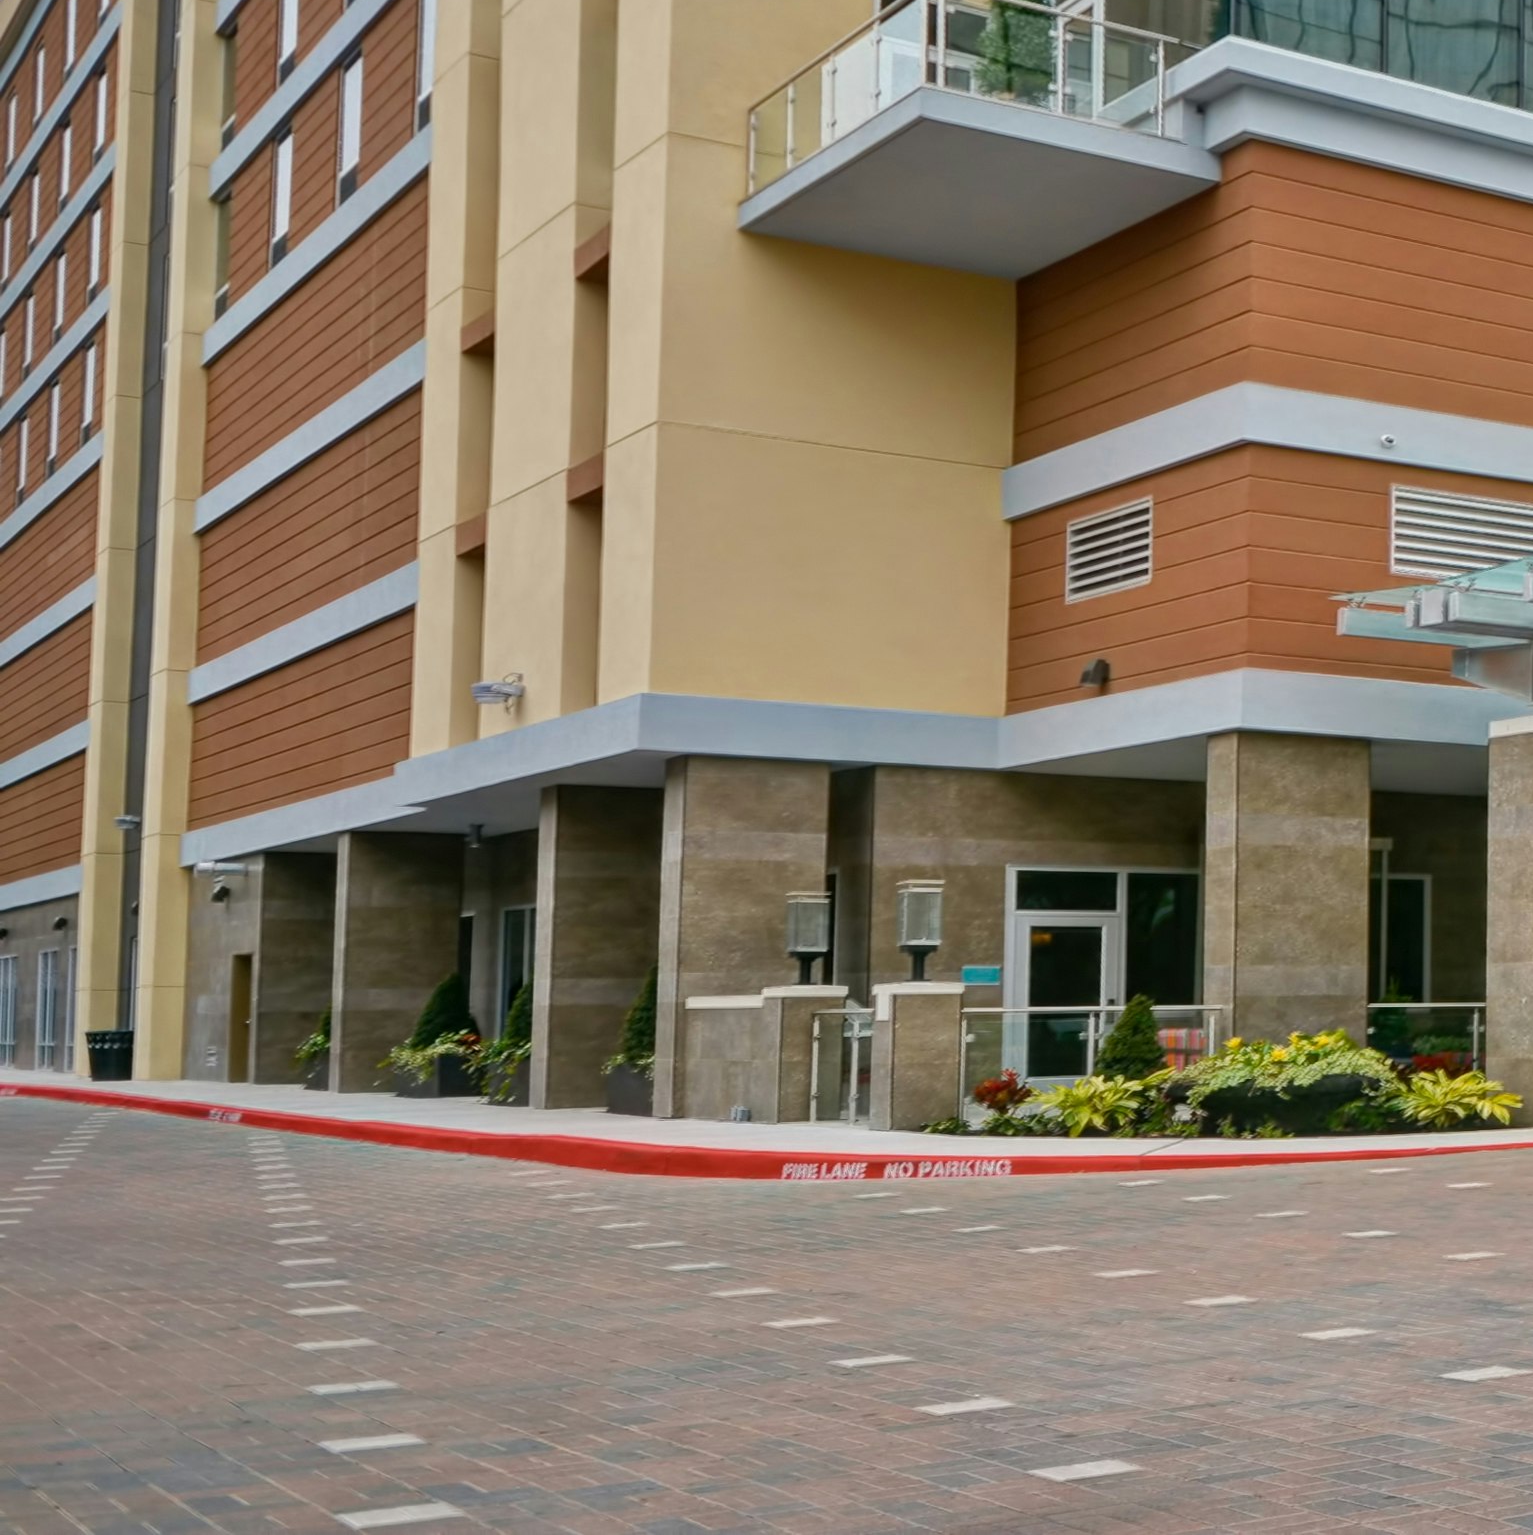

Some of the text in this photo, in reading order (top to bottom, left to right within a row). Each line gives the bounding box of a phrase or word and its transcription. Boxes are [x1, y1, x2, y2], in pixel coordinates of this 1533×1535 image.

[780, 1159, 1012, 1179] FIRE LANE NO PARKING
